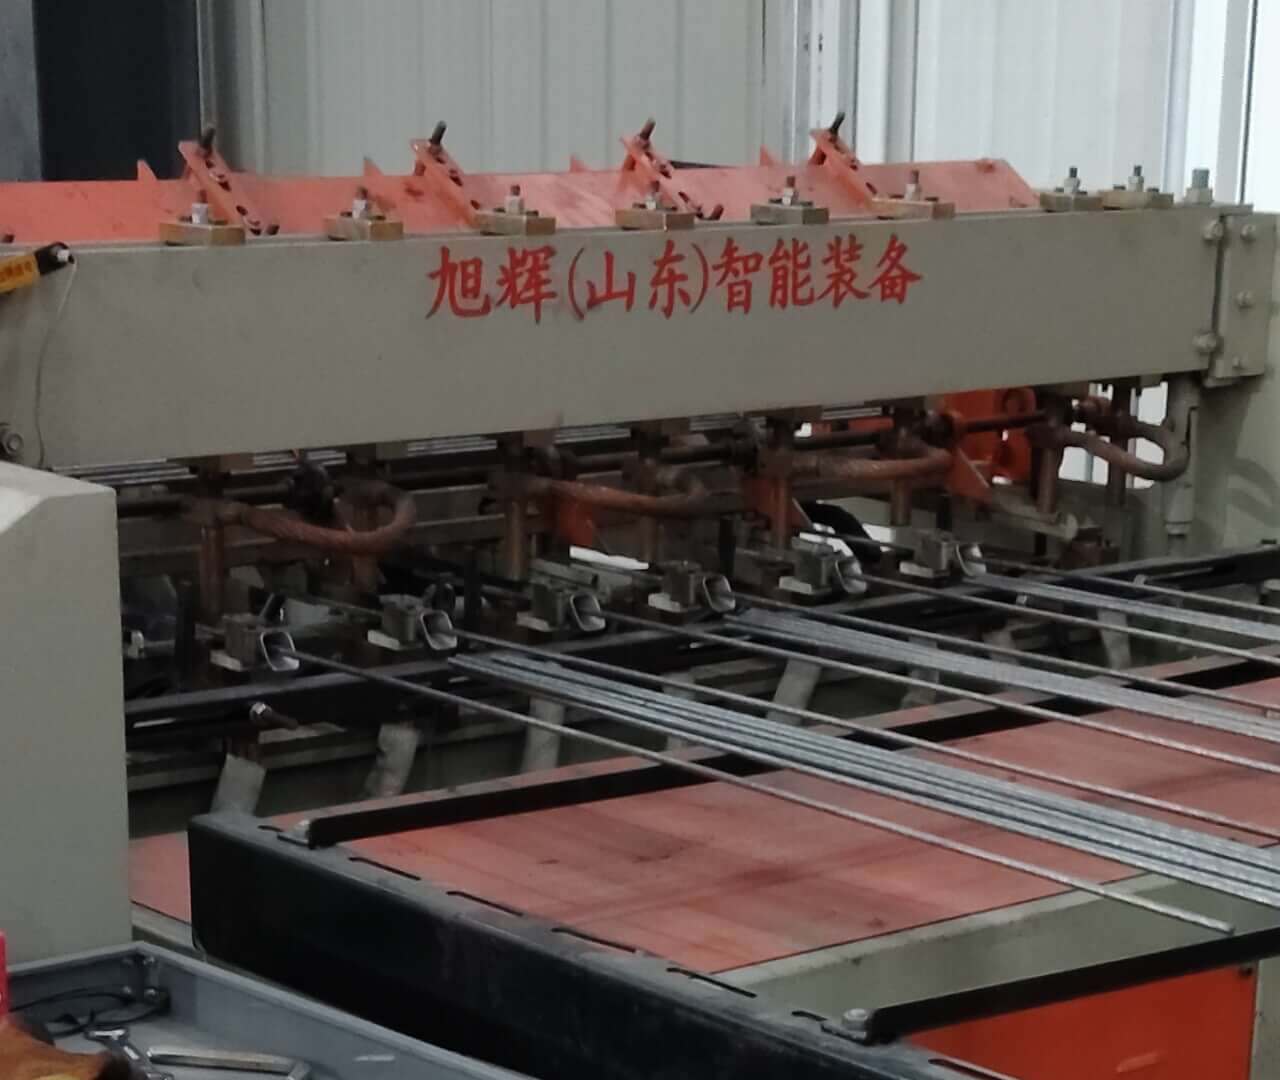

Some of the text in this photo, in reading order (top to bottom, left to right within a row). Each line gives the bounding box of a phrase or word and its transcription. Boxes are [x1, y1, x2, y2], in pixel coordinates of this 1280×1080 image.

[425, 234, 922, 324] 旭辉(山东)智能装备
